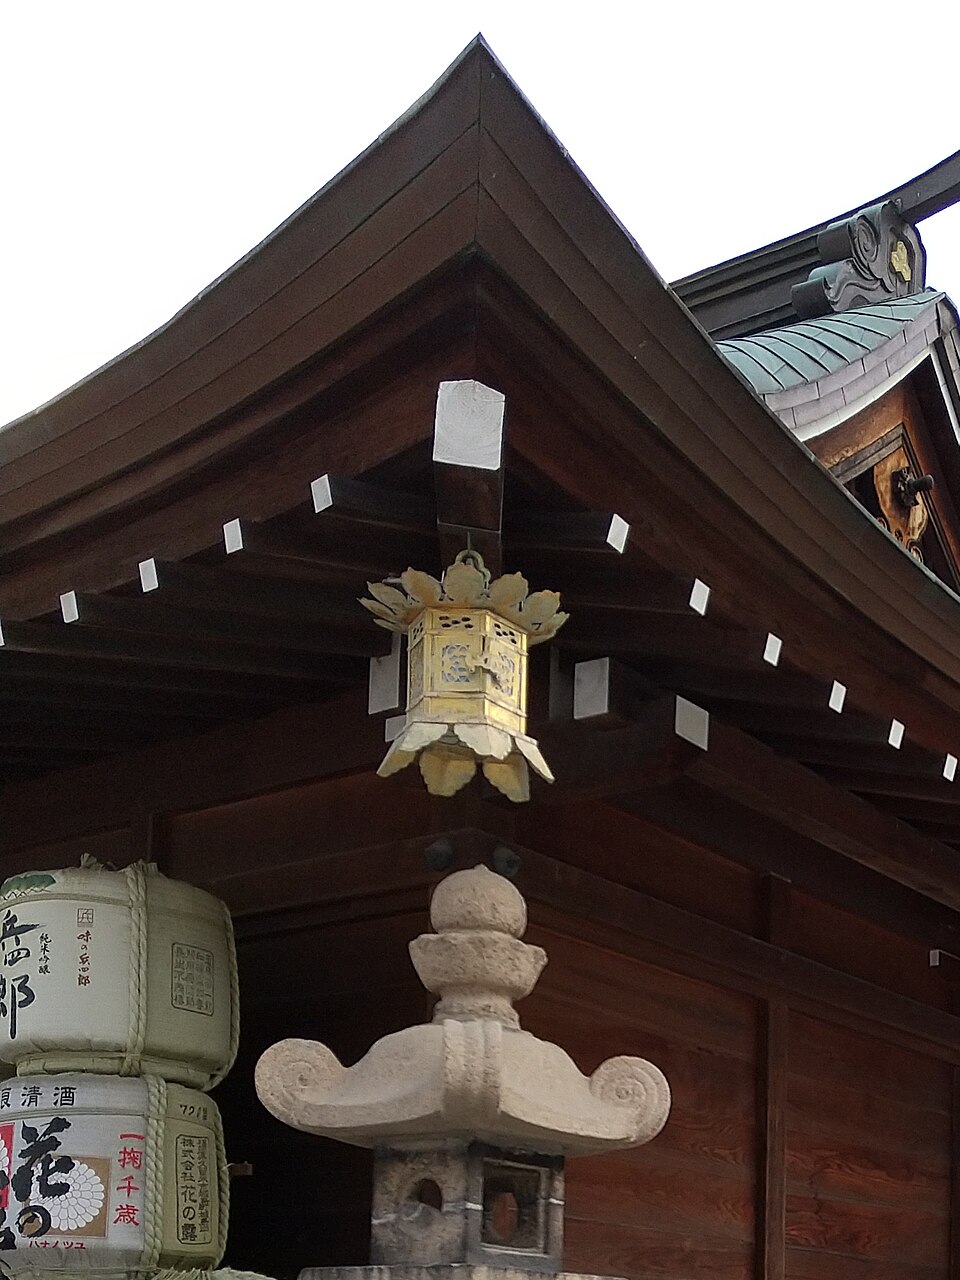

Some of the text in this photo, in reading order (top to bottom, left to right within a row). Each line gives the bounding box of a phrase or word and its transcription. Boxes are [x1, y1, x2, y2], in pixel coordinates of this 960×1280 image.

[39, 933, 52, 974] 純米吟醸
[77, 930, 92, 986] 味の兵四郎
[113, 1132, 145, 1226] 一掬千歳
[28, 1240, 86, 1250] ハナノツユ
